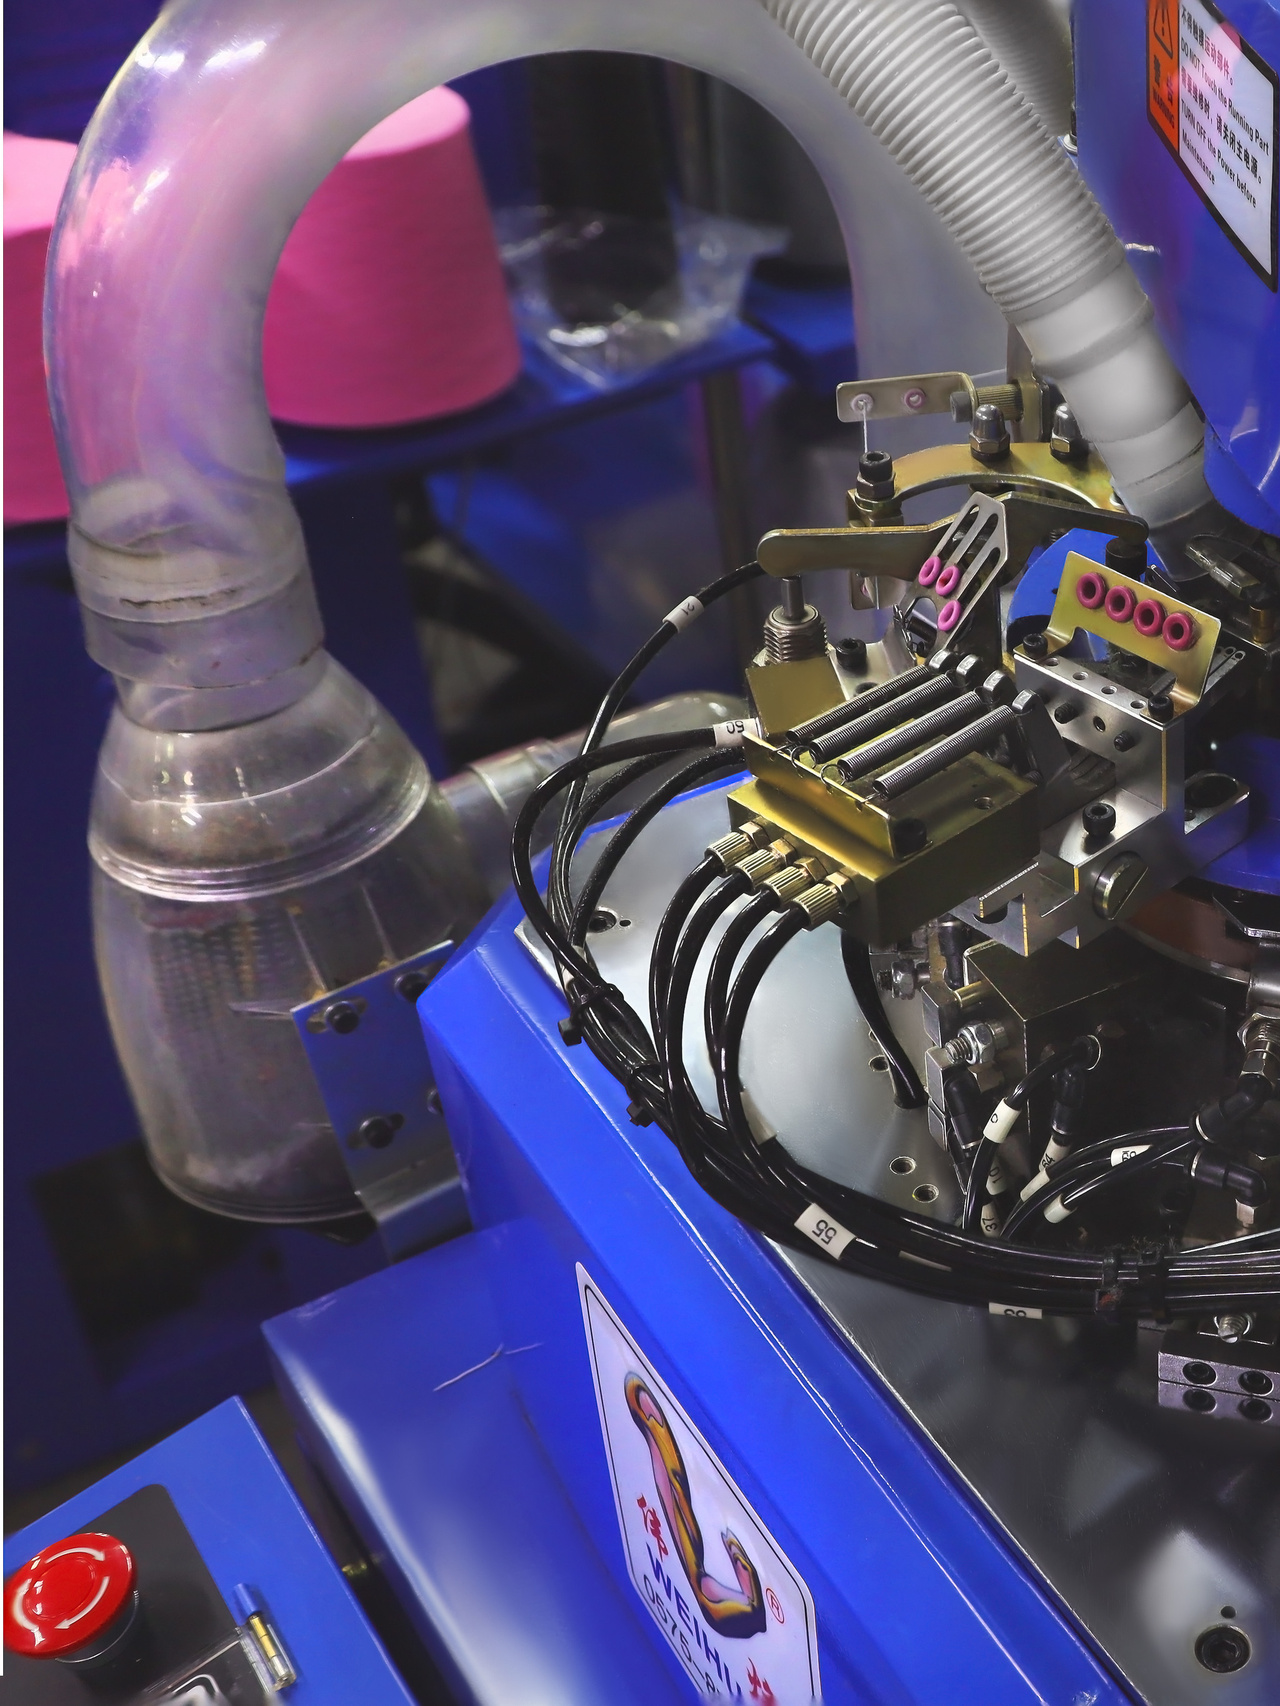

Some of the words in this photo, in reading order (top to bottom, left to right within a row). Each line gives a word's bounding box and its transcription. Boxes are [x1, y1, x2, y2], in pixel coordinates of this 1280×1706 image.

[1181, 37, 1189, 58] DO
[1190, 48, 1200, 72] NOT
[1218, 87, 1228, 108] the
[1228, 98, 1254, 142] Running
[1254, 128, 1269, 156] Part
[1181, 99, 1196, 129] TURN
[1196, 121, 1207, 143] OFF
[1207, 137, 1217, 158] the
[1217, 149, 1236, 182] Power
[1237, 174, 1257, 208] before
[1182, 129, 1215, 185] Maintenance
[811, 1218, 838, 1245] 55
[982, 1217, 998, 1232] 37
